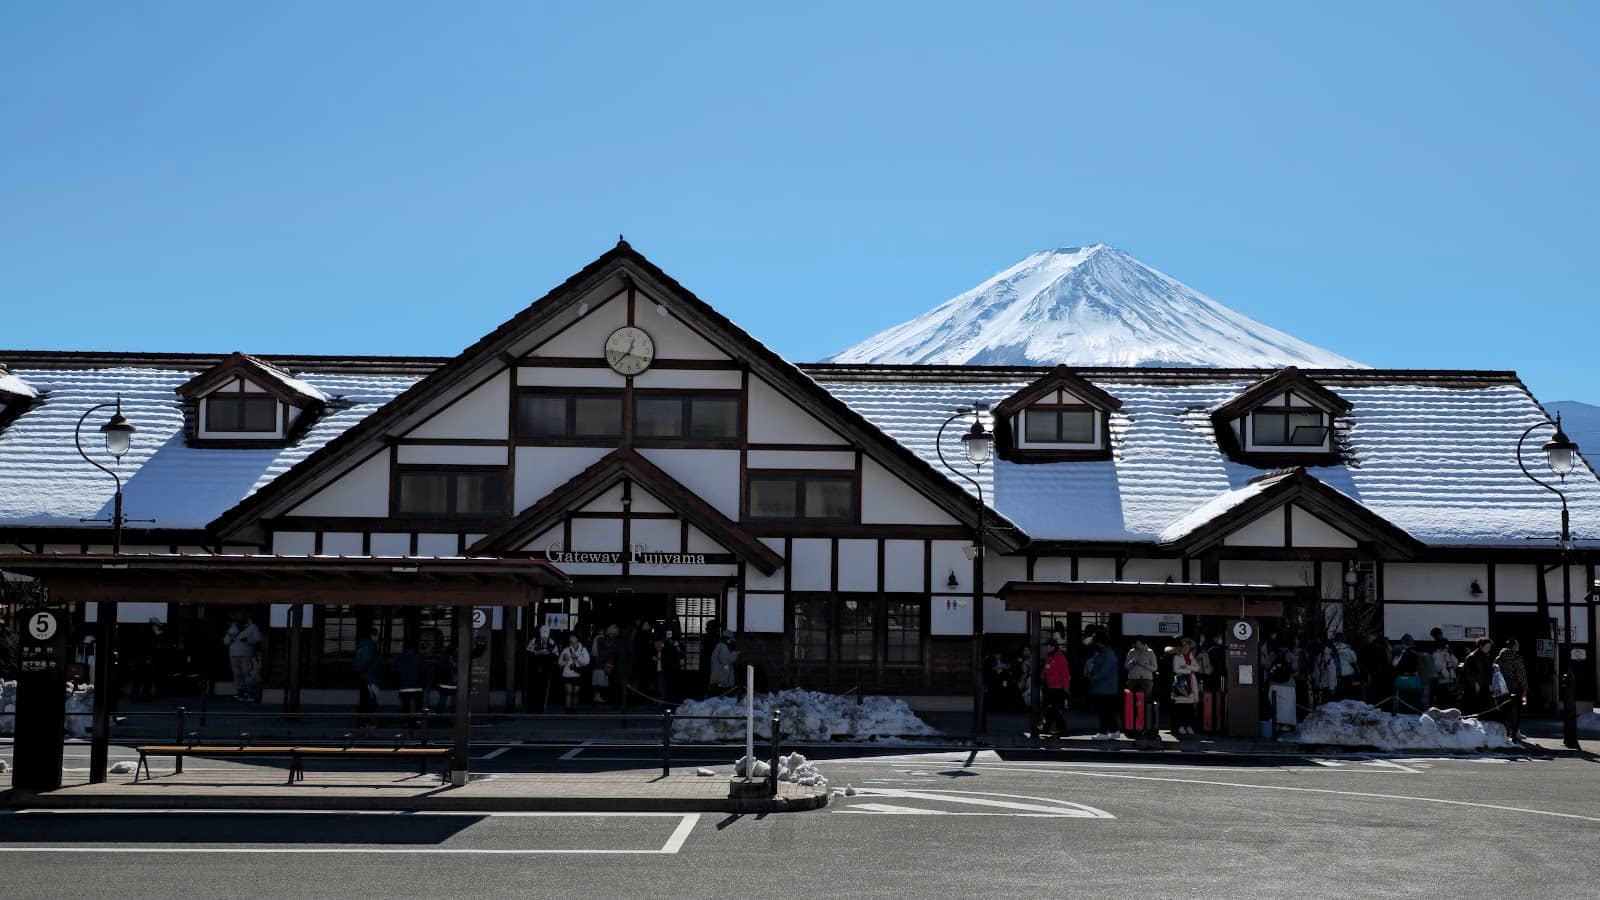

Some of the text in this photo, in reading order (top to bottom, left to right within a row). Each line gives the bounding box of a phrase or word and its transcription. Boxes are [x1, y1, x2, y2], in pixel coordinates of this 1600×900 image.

[545, 543, 705, 567] Gateway Fujiyama
[36, 614, 49, 633] 5
[473, 611, 481, 622] 2
[1238, 623, 1247, 635] 3
